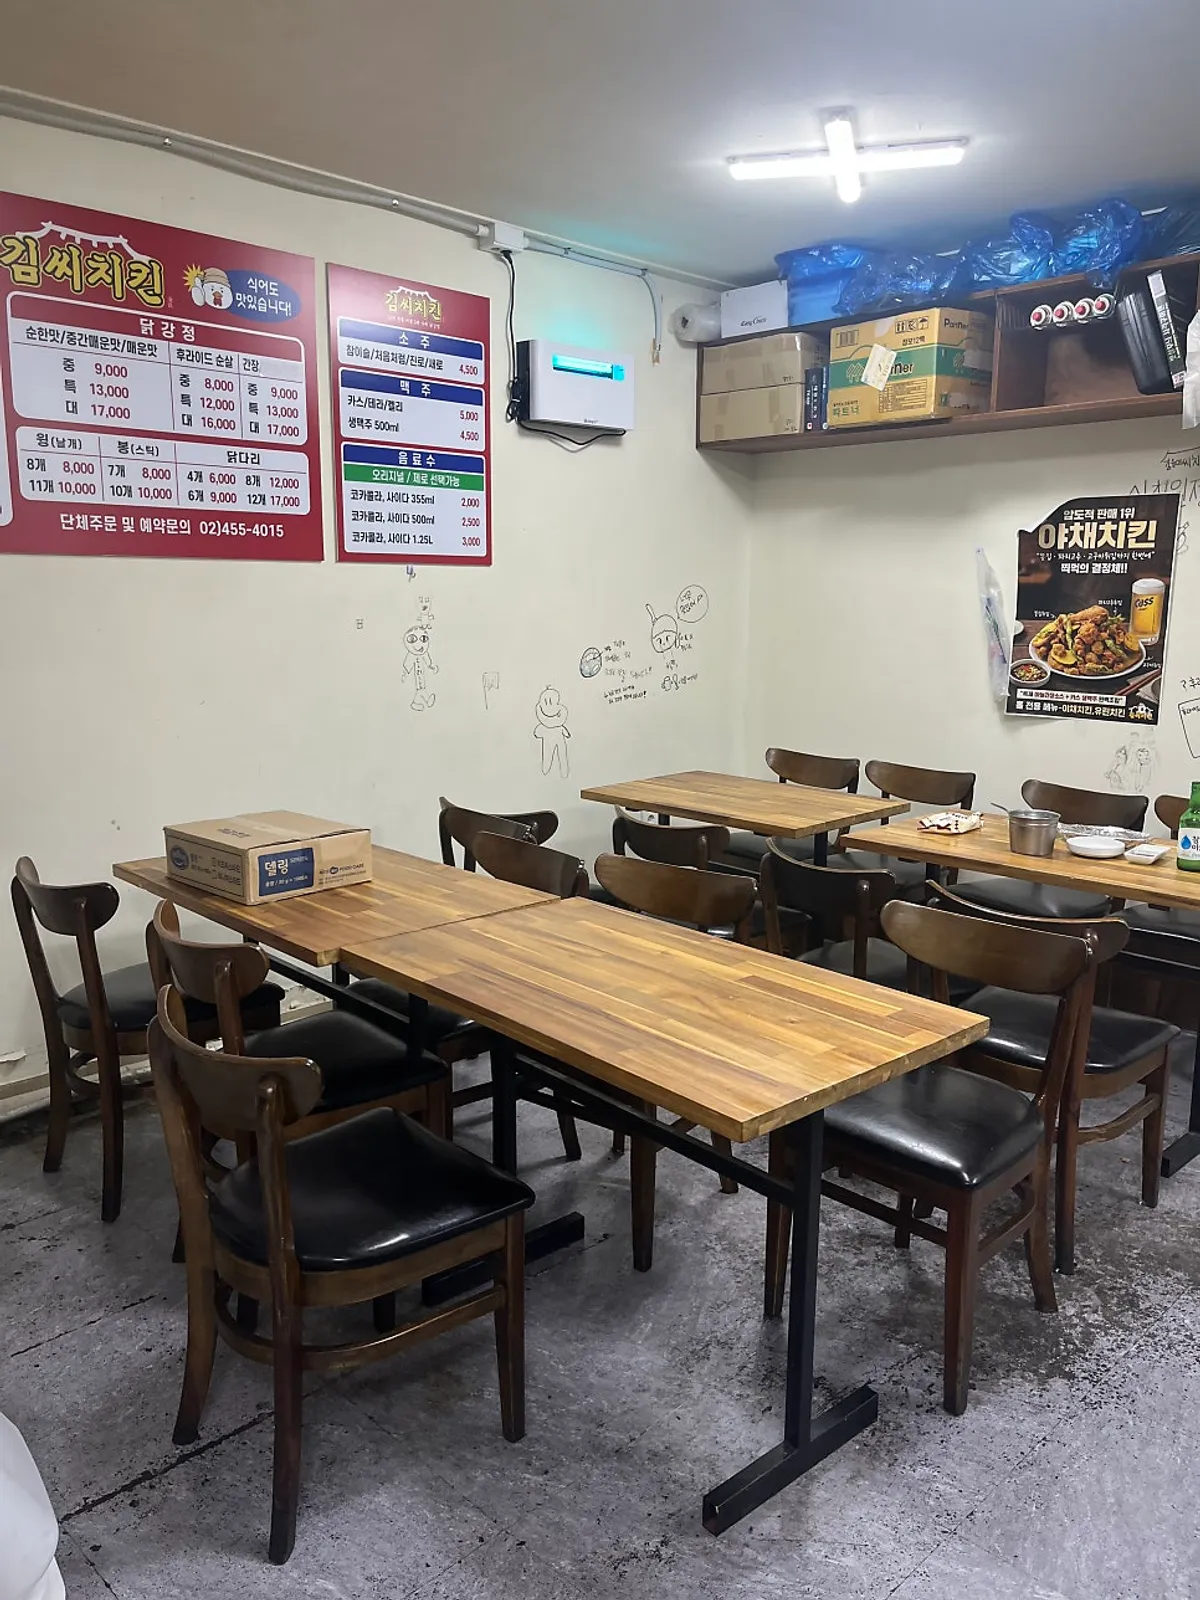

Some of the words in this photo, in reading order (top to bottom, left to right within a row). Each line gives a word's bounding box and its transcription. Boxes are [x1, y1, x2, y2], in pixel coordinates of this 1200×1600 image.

[0, 235, 165, 308] 김씨치킨
[247, 277, 279, 297] 식어도
[236, 293, 292, 317] 맛있습니다!
[26, 325, 158, 358] 순한맛/중간매운맛/매운맛
[176, 348, 213, 366] 후라이드
[214, 353, 234, 369] 순살
[242, 357, 259, 373] 간장
[62, 357, 76, 373] 중
[94, 362, 128, 379] 9,000
[346, 344, 444, 371] 참이슬/처음처럼/진로/새로
[459, 364, 478, 376] 4,500
[64, 379, 77, 394] 특
[89, 383, 130, 400] 13,000
[178, 373, 191, 388] 중
[204, 377, 235, 394] 8,000
[247, 382, 258, 397] 중
[270, 387, 299, 401] 9,000
[65, 400, 78, 415] 대
[91, 403, 131, 420] 17,000
[180, 393, 191, 407] 특
[200, 397, 236, 412] 12,000
[249, 401, 259, 416] 특
[266, 405, 300, 420] 13,000
[347, 394, 403, 413] 카스/테라/켈리
[460, 411, 478, 421] 5,000
[182, 413, 193, 428] 대
[201, 416, 237, 431] 16,000
[249, 421, 260, 435] 대
[267, 423, 300, 438] 17,000
[348, 416, 373, 430] 생맥주
[374, 419, 400, 433] 500ml
[460, 431, 479, 441] 4,500
[36, 433, 83, 450] 윙(날개)
[117, 441, 160, 458] 봉(스틱)
[27, 458, 47, 473] 8개
[63, 461, 95, 476] 8,000
[227, 450, 261, 466] 닭다리
[108, 464, 126, 479] 7개
[142, 467, 172, 481] 8,000
[187, 471, 204, 484] 4개
[209, 472, 237, 486] 6,000
[245, 475, 261, 488] 8개
[269, 477, 300, 490] 12,000
[372, 469, 405, 484] 오리지널
[413, 473, 429, 485] 제로
[430, 475, 460, 488] 선택가능
[29, 480, 55, 494] 11개
[58, 481, 96, 497] 10,000
[110, 485, 133, 499] 10개
[138, 487, 173, 501] 10,000
[188, 490, 205, 503] 6개
[210, 491, 238, 505] 9,000
[247, 493, 267, 507] 12개
[270, 493, 301, 508] 17,000
[386, 491, 410, 504] 사이다
[411, 493, 435, 505] 355ml
[461, 498, 480, 508] 2,000
[387, 512, 410, 524] 사이다
[411, 514, 435, 526] 500ml
[462, 517, 481, 528] 2,500
[1063, 508, 1095, 521] 압도적
[1097, 507, 1118, 520] 판매
[1120, 506, 1136, 520] 1위
[60, 513, 118, 533] 단체주문
[122, 516, 136, 534] 및
[140, 519, 192, 536] 예약문의
[199, 520, 285, 538] 02)455-4015
[1038, 520, 1157, 550] 야채치킨
[388, 533, 411, 545] 사이다
[413, 534, 434, 546] 1.25L
[462, 537, 481, 548] 3,000
[1091, 562, 1128, 575] 결정체!!
